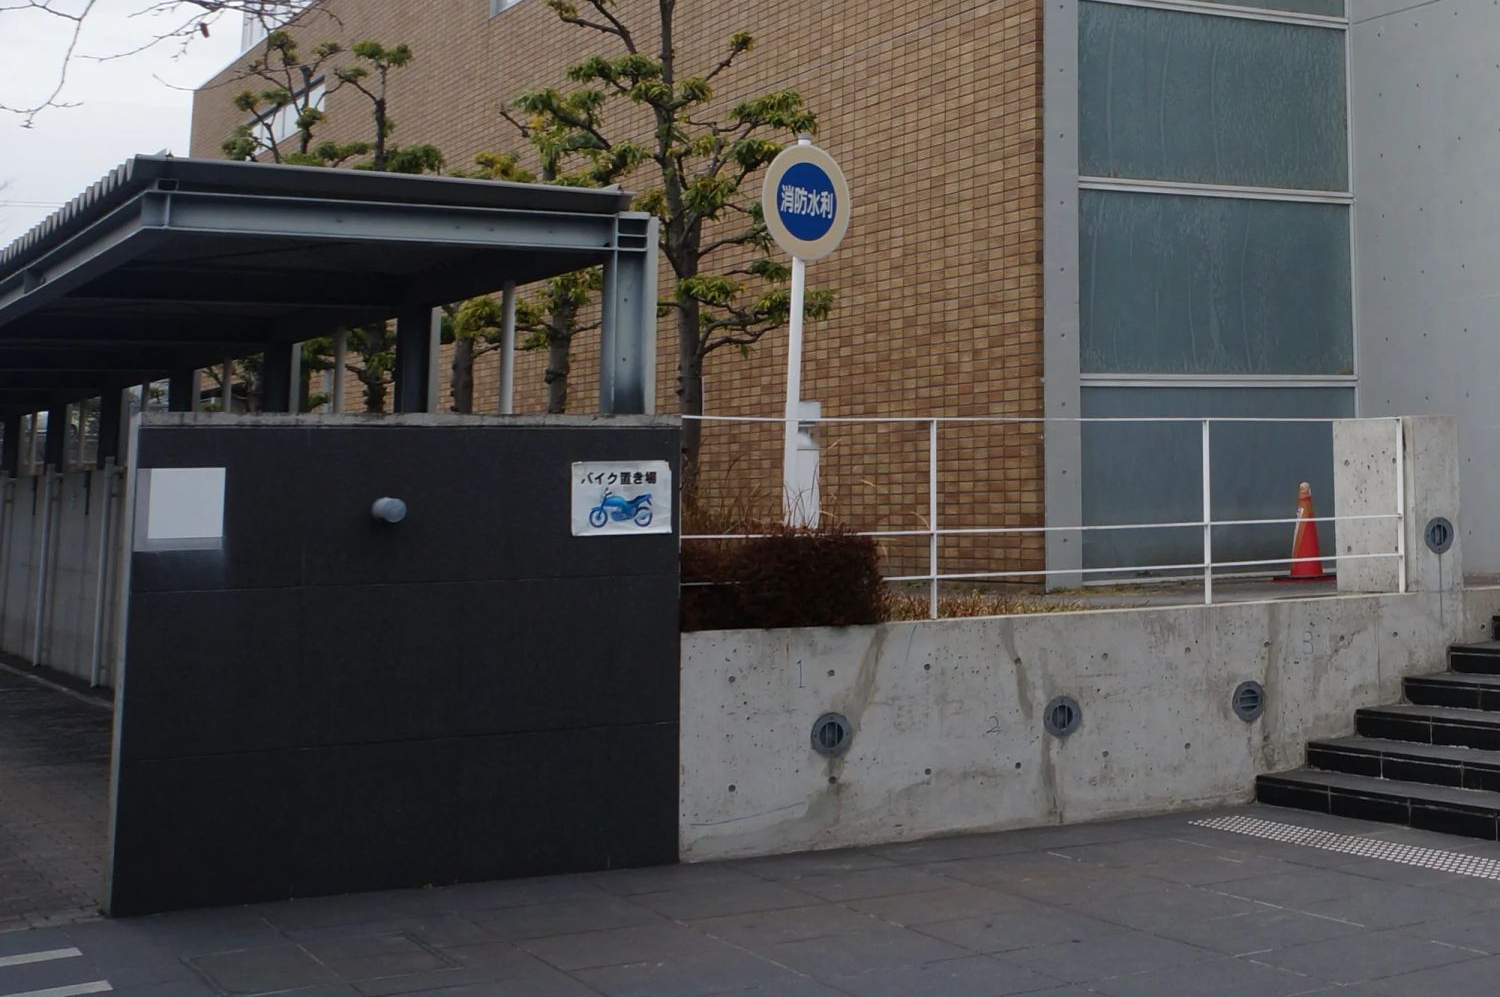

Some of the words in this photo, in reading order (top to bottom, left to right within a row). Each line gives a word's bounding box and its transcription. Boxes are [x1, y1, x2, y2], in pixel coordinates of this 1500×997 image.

[781, 184, 834, 219] 消防水利
[580, 471, 657, 485] バイク置き場
